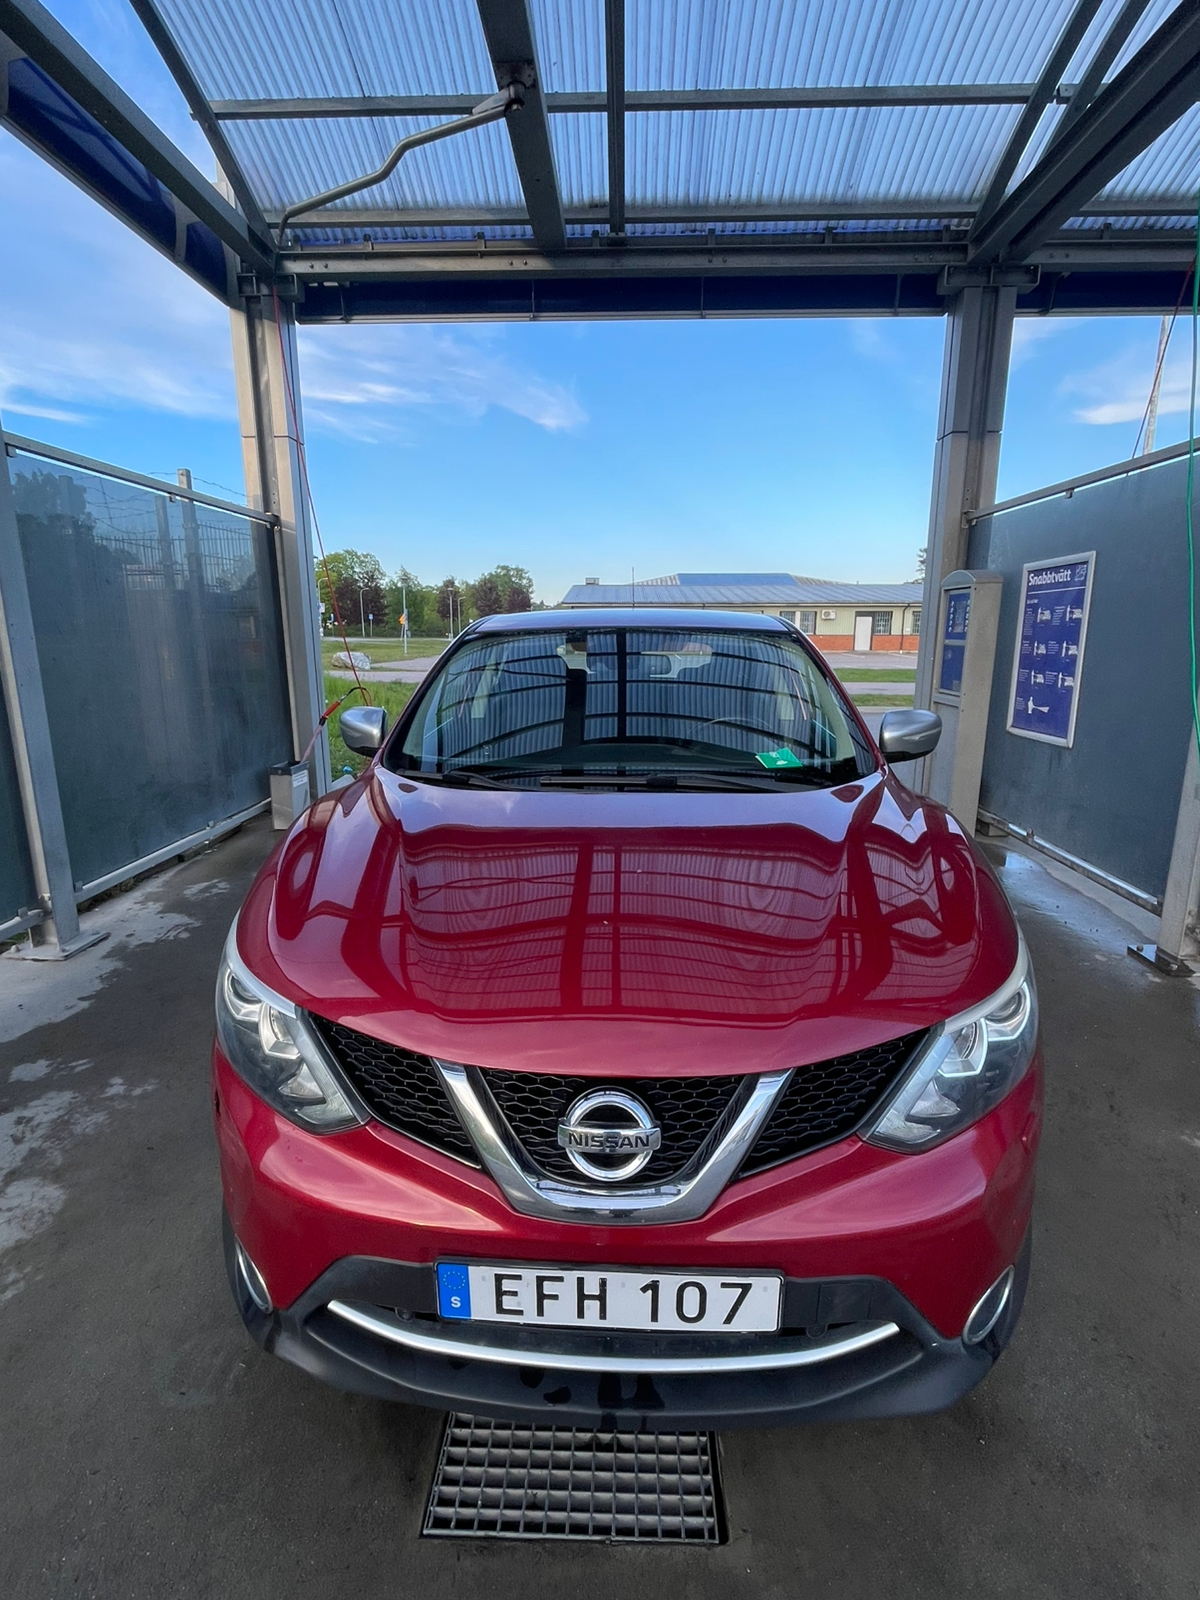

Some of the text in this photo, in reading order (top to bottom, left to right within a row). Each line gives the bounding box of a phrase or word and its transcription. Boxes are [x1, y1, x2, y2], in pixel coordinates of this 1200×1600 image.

[1029, 569, 1072, 586] Snabbtvätt
[568, 1131, 649, 1149] NISSAN
[451, 1296, 461, 1308] S
[494, 1273, 753, 1325] EFH 107
